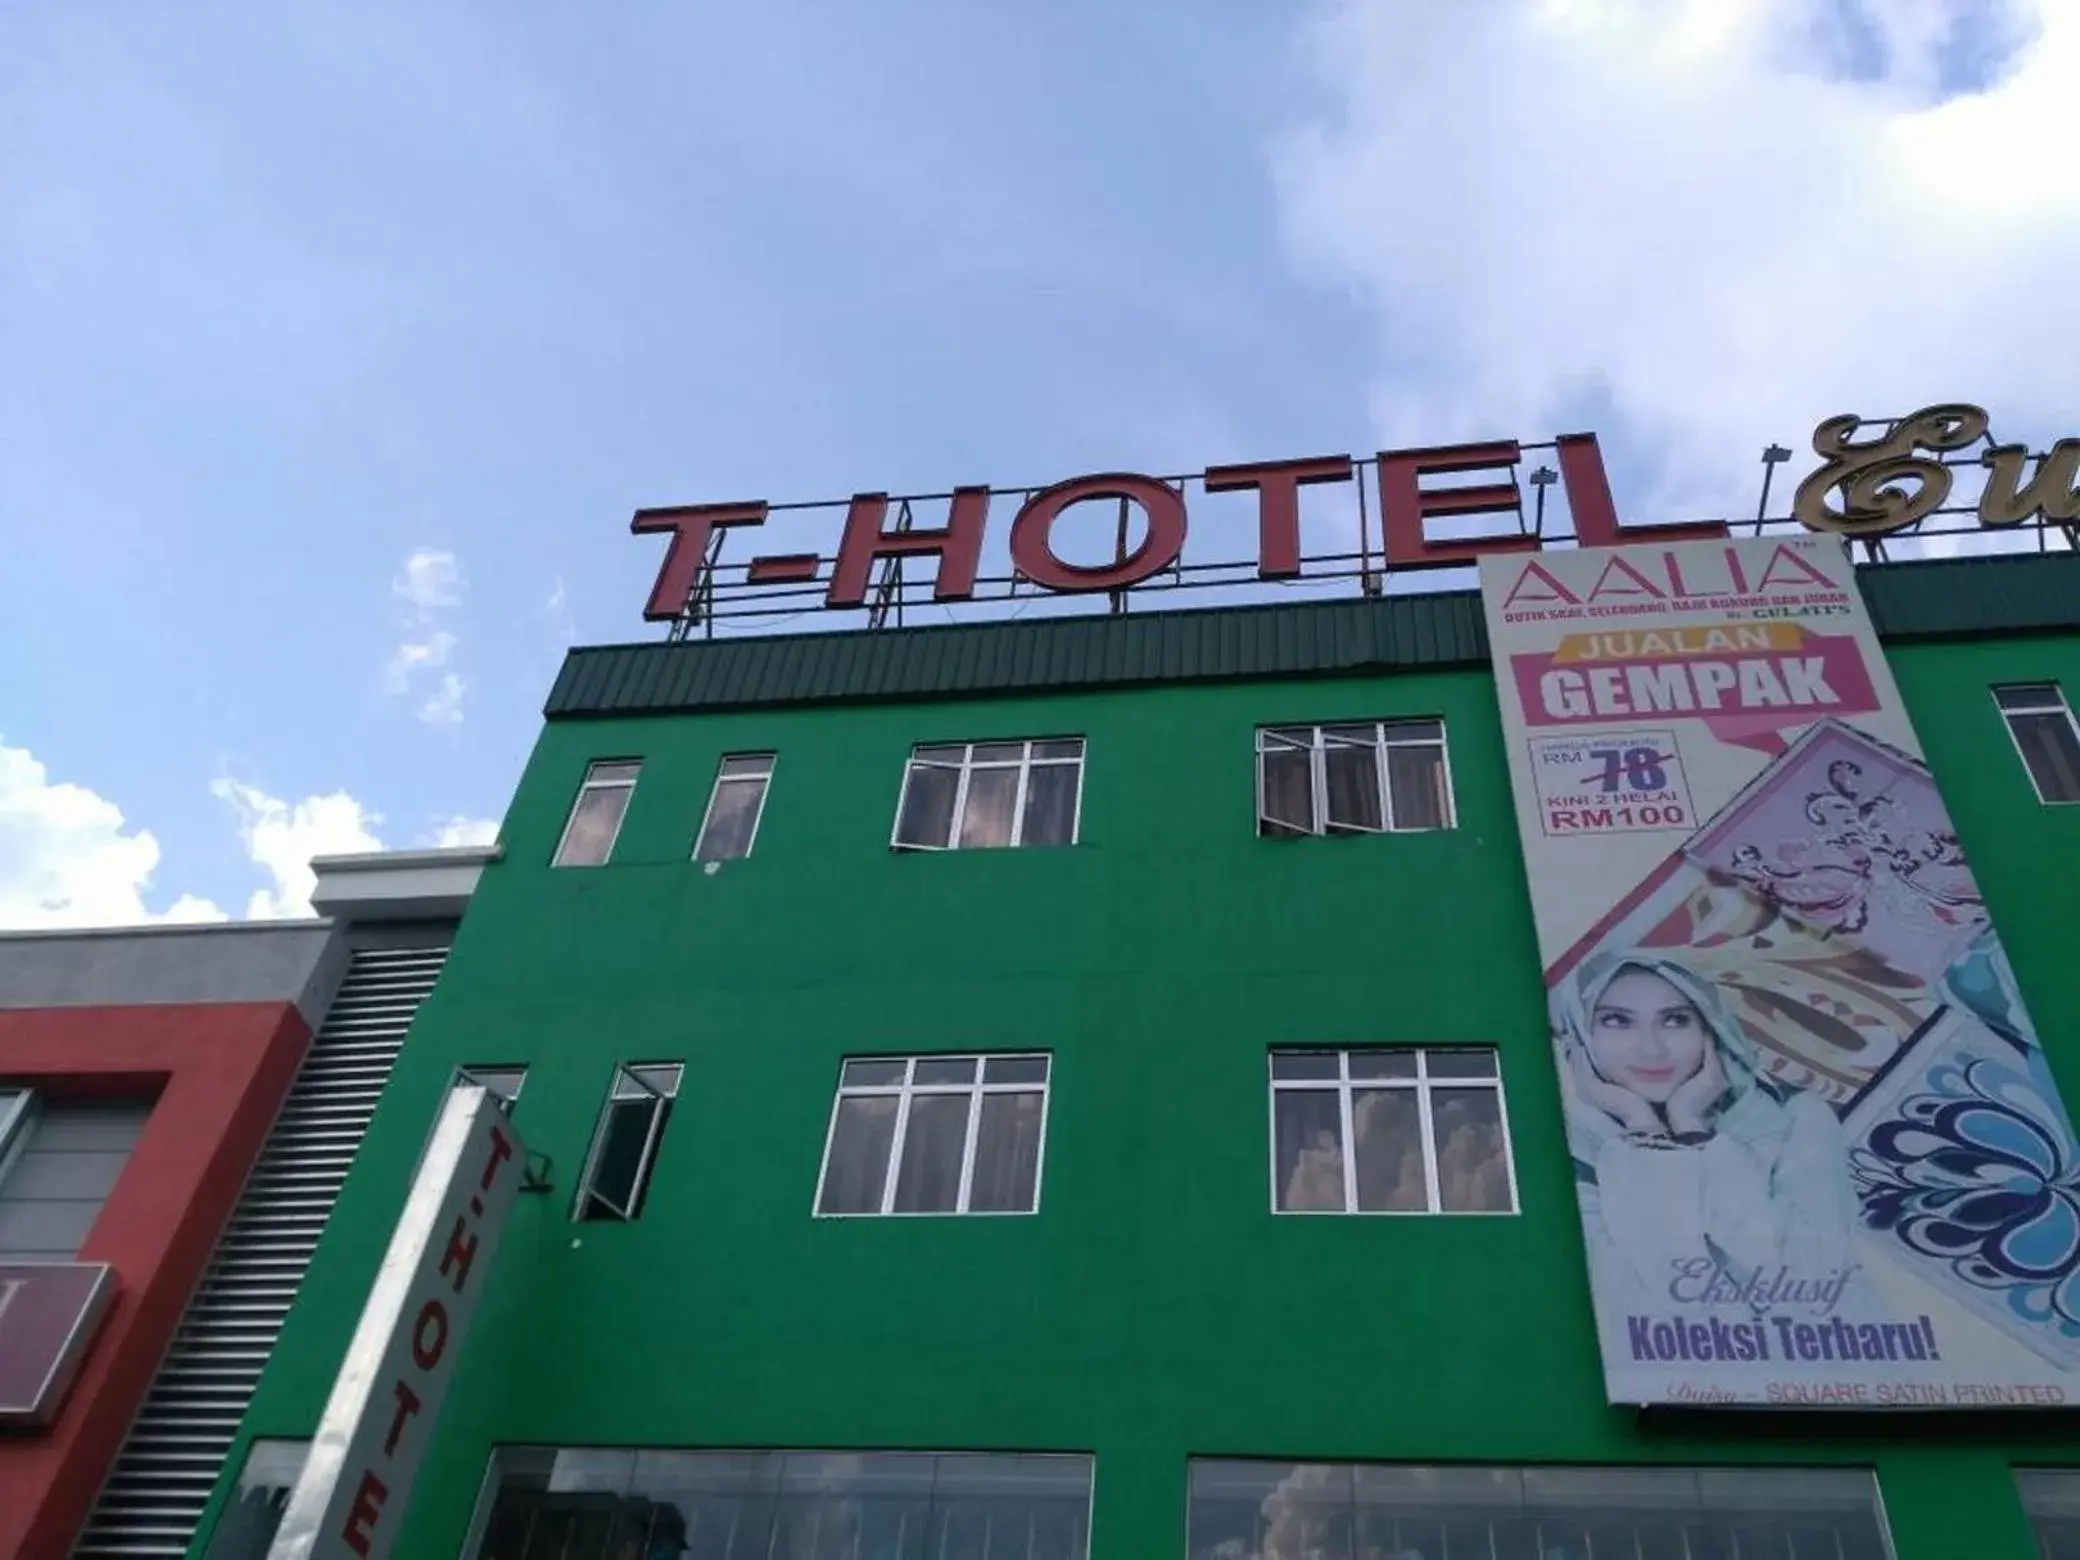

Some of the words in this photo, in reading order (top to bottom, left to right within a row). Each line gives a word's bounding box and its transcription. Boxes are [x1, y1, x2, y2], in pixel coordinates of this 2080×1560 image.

[630, 433, 1733, 622] T-HOTEL
[1503, 542, 1839, 609] AALIA
[1577, 624, 1773, 660] JUALAN
[1540, 656, 1841, 719] GEMPAK
[1543, 750, 1583, 765] RM
[1550, 804, 1685, 830] RM100
[1626, 1314, 1770, 1362] Koleksi
[1772, 1314, 1941, 1362] Terbaru!
[1765, 1381, 1868, 1403] SQUARE
[1875, 1382, 1948, 1403] SATIN
[1953, 1383, 2067, 1404] PRINTED
